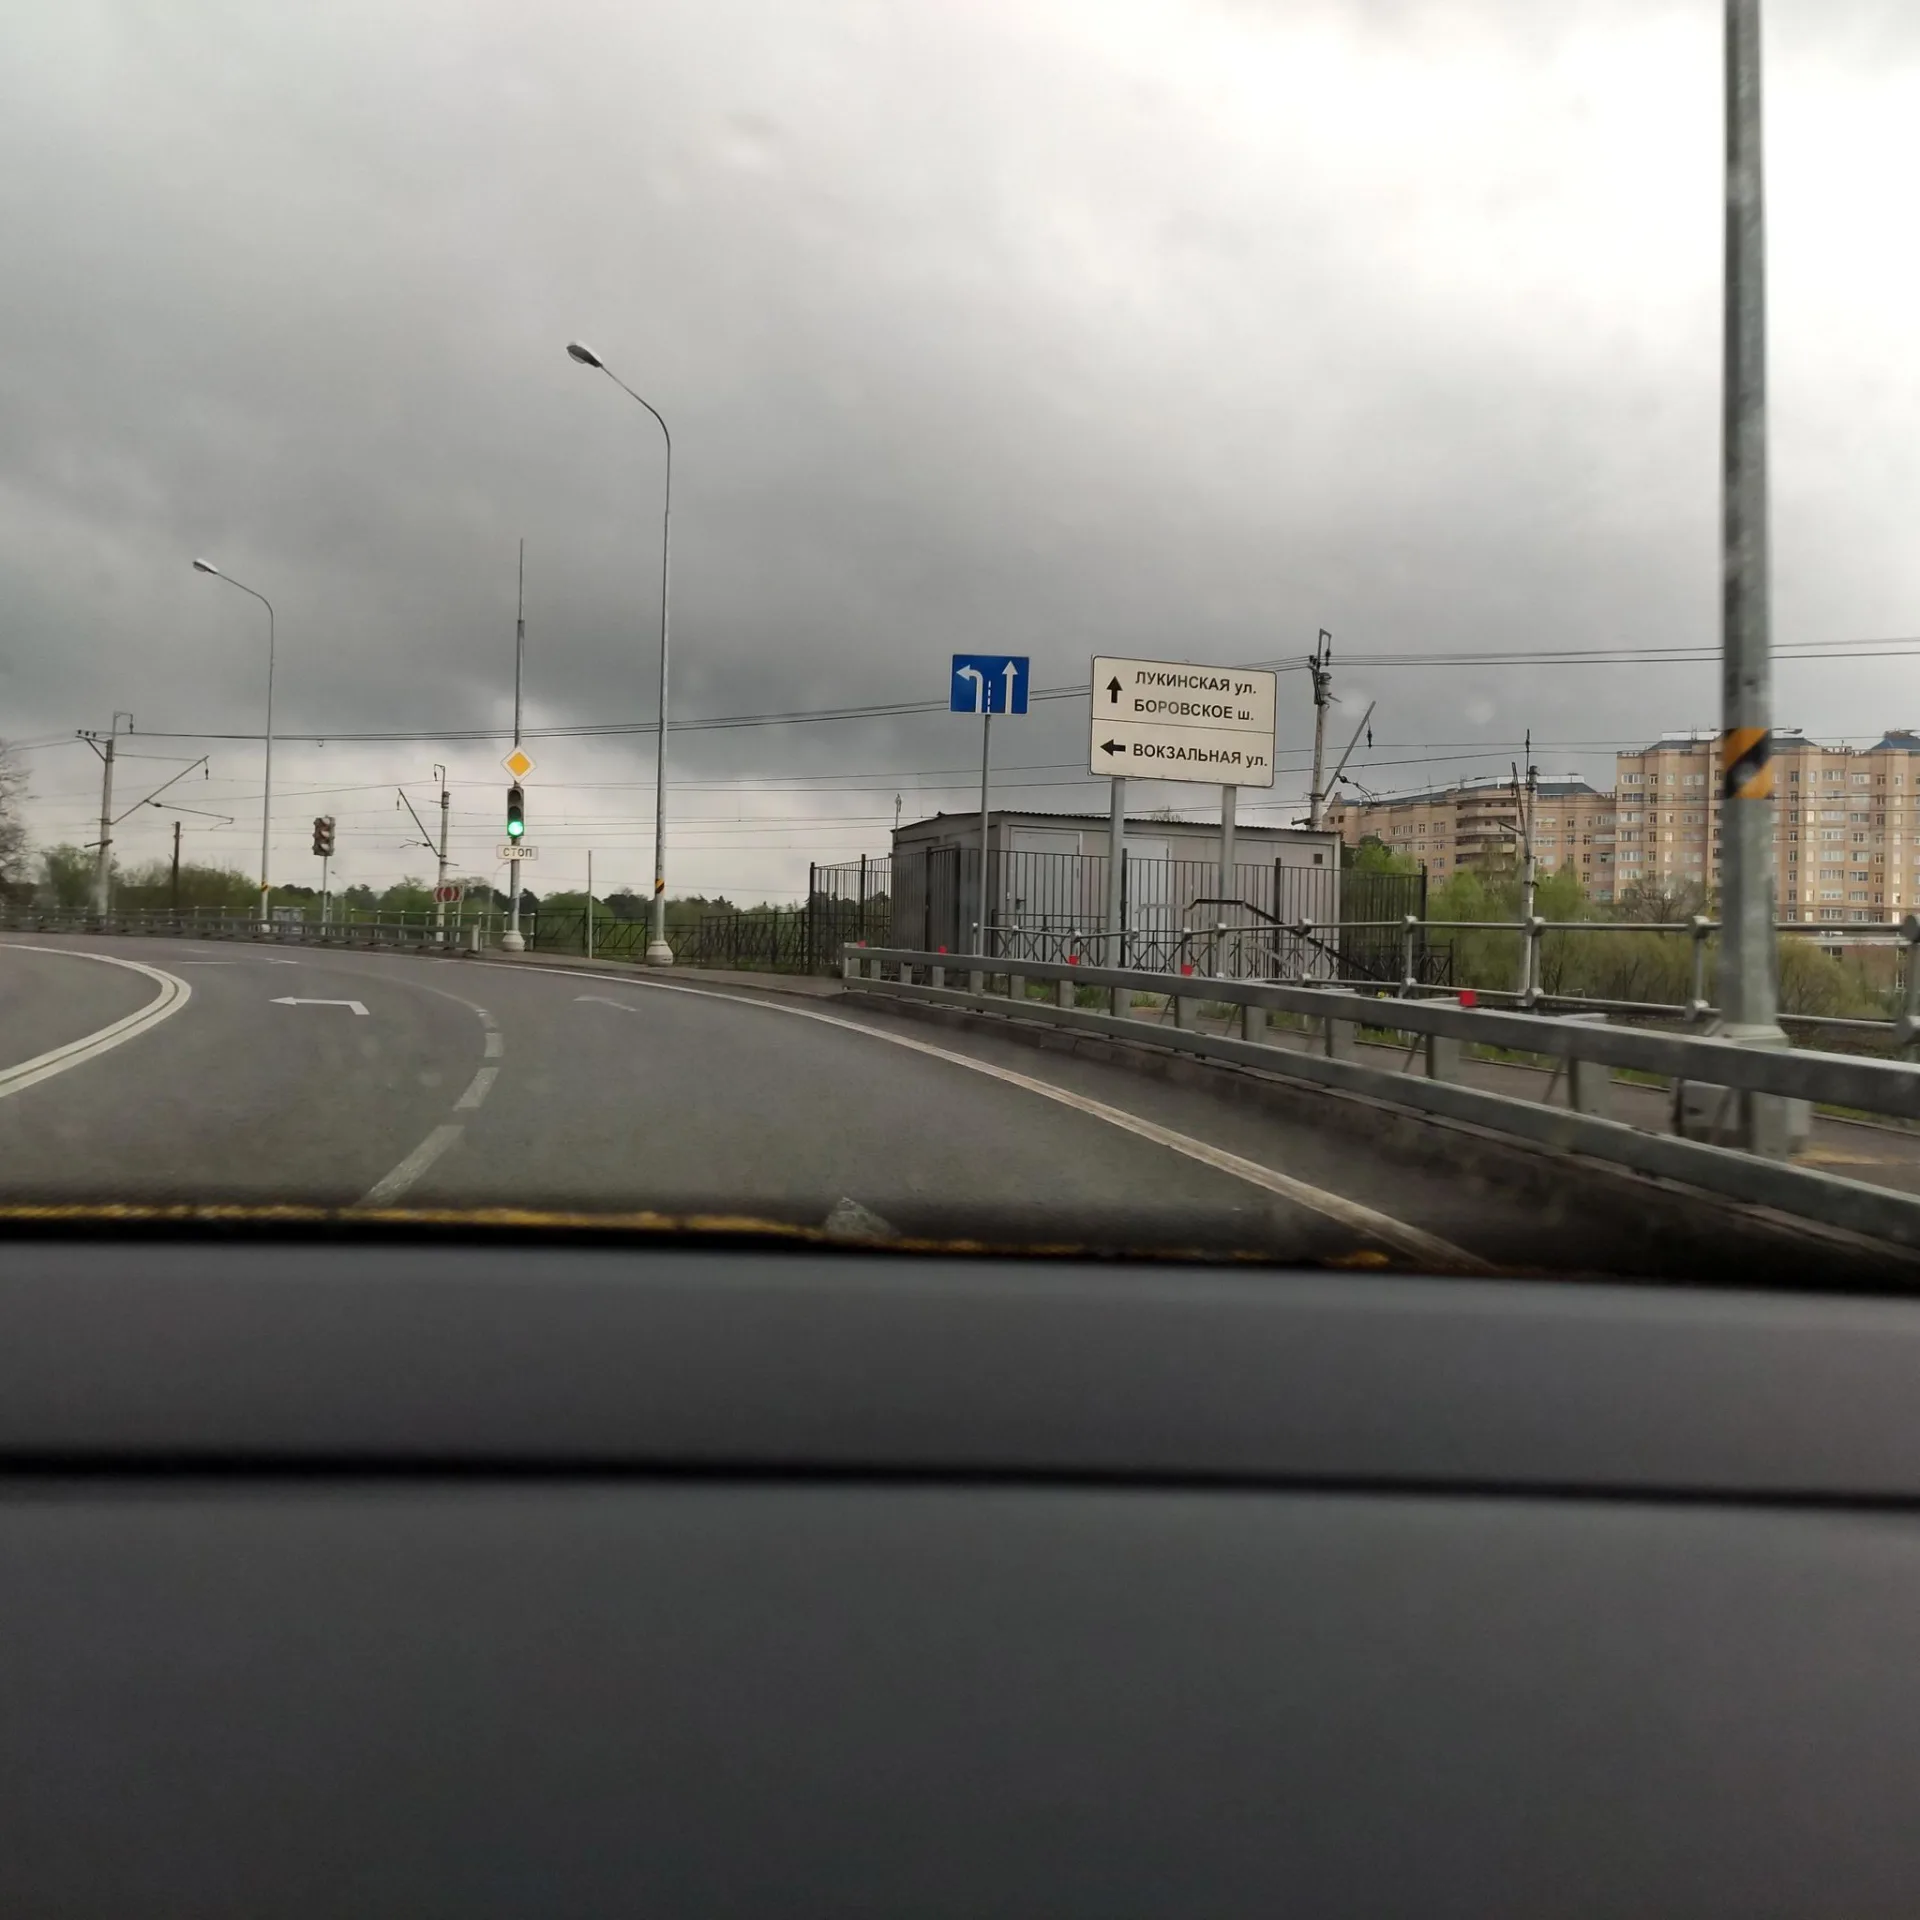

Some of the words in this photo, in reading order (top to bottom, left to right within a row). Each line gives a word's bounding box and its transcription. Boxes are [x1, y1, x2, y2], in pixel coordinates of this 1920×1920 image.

[1135, 671, 1230, 691] ЛУКИНСКАЯ
[1234, 682, 1257, 696] ул.
[1134, 699, 1233, 719] БОРОВСКОЕ
[1238, 709, 1254, 721] ш.
[1133, 743, 1241, 764] ВОКЗАЛЬНАЯ
[1246, 754, 1268, 768] ул.
[503, 847, 533, 857] СТОП
